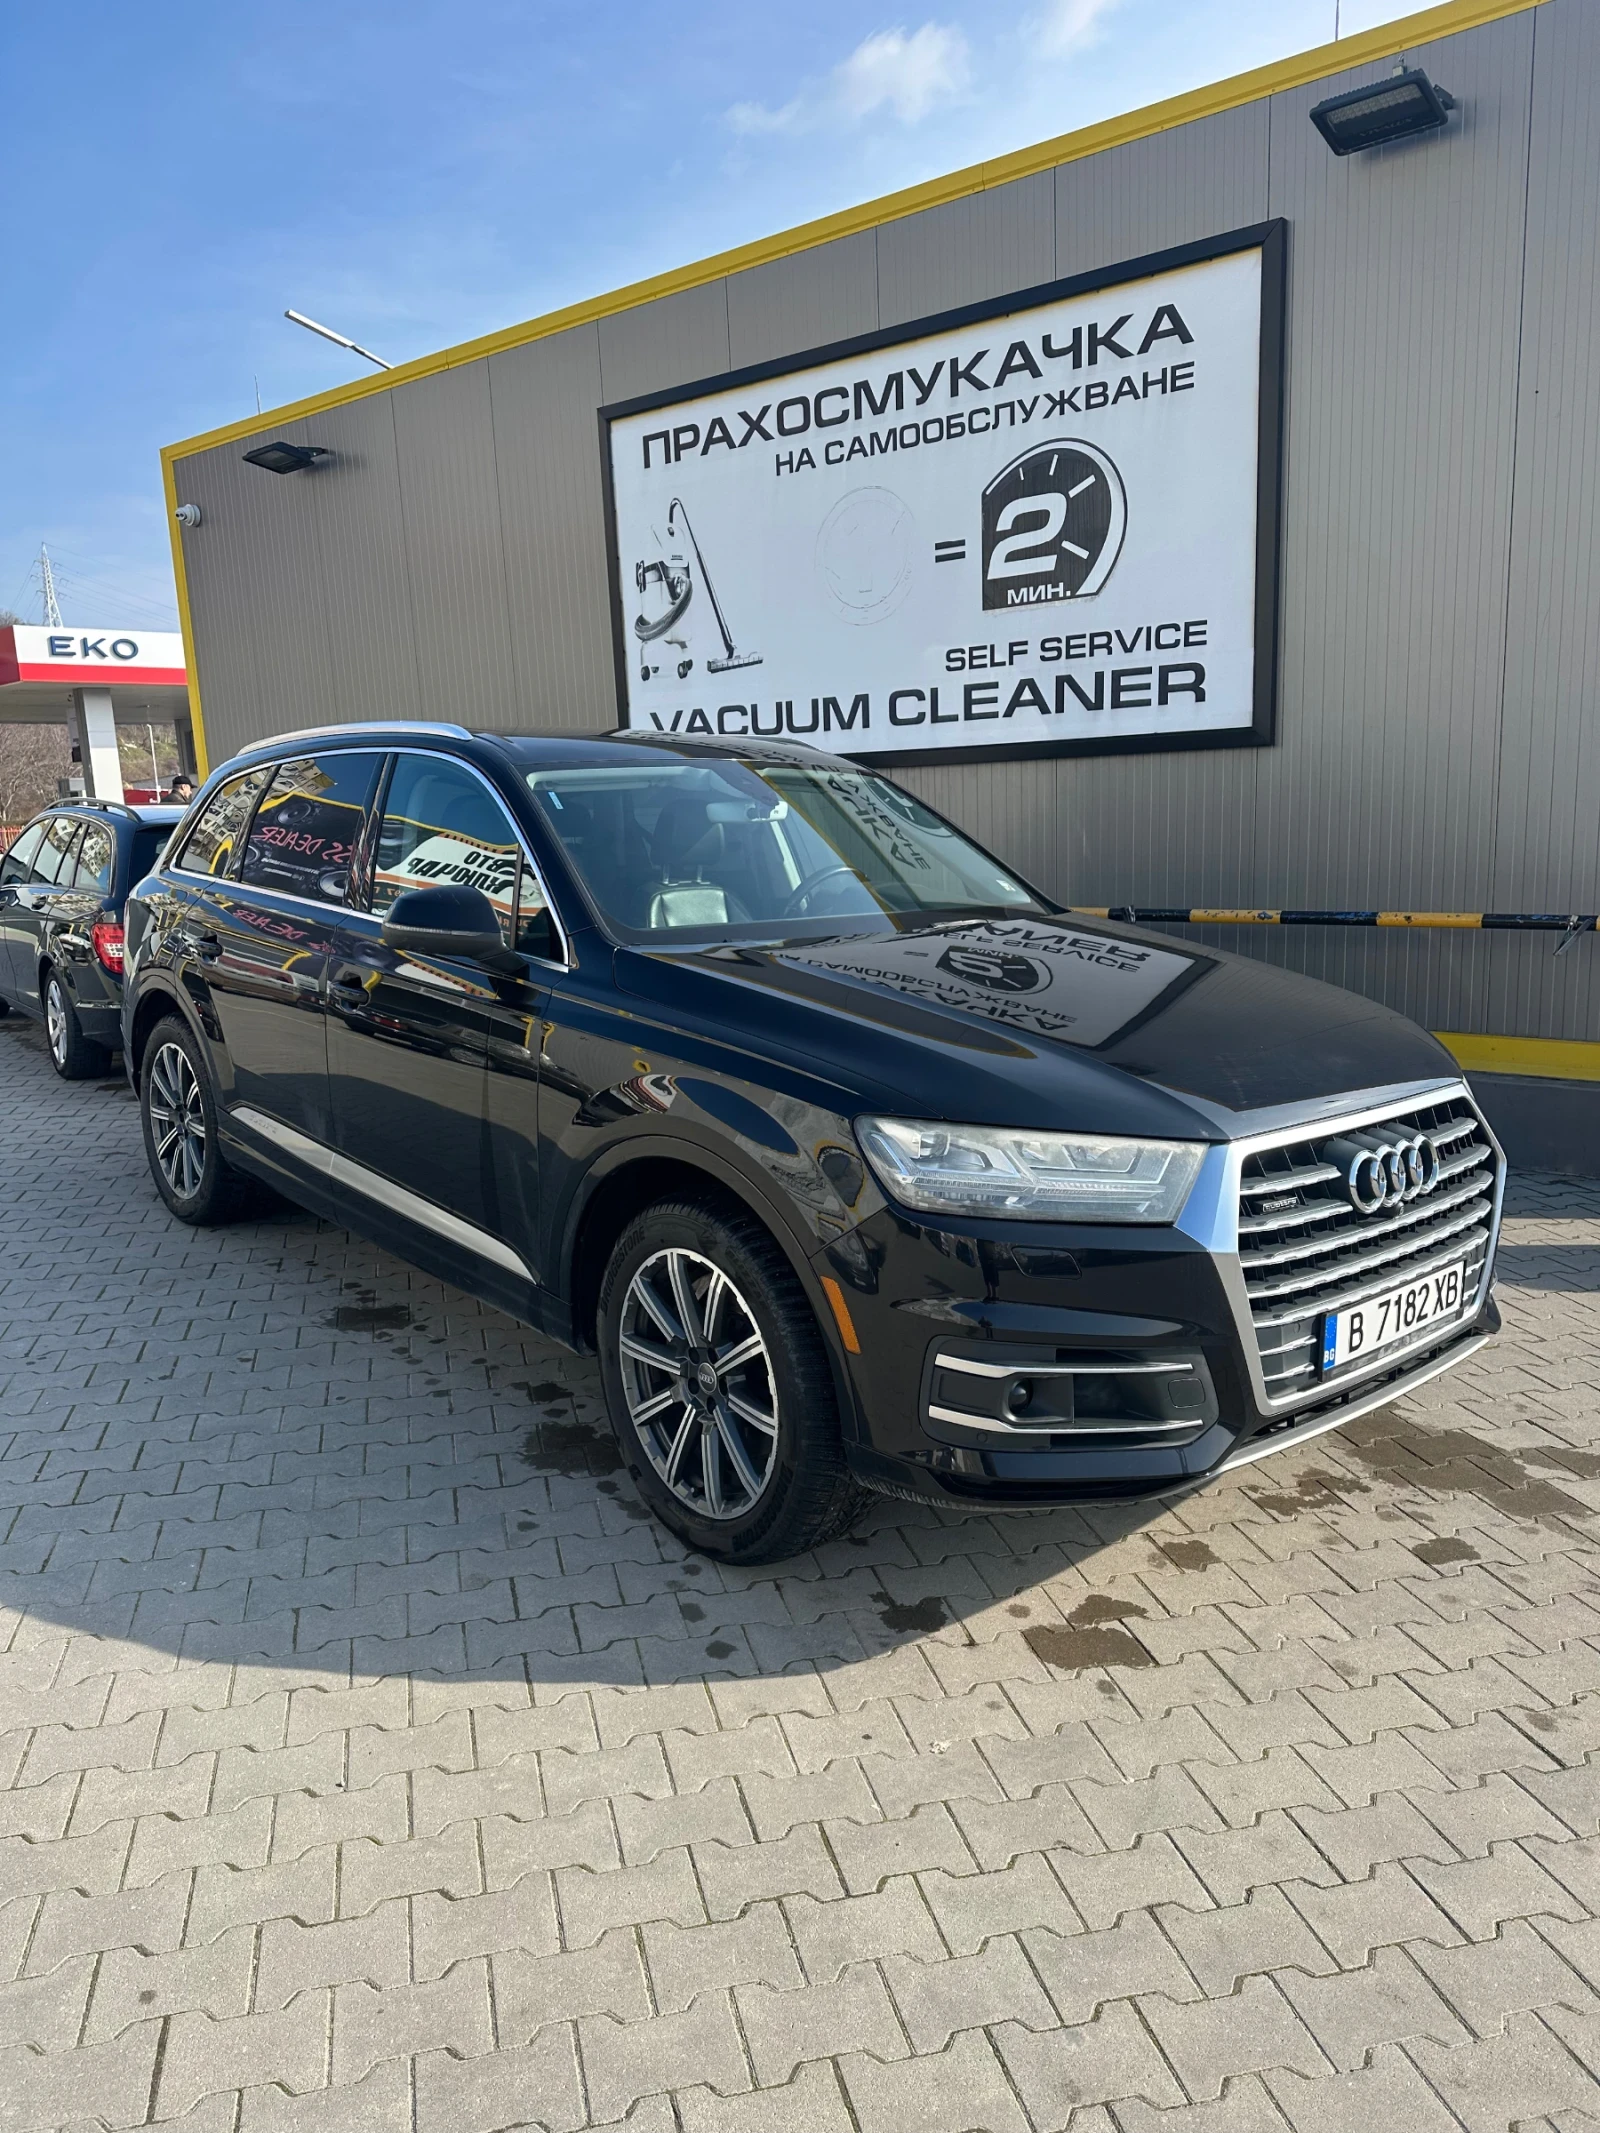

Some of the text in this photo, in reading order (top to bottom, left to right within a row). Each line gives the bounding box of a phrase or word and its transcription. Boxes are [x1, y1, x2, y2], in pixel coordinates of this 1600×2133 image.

[642, 303, 1195, 469] ПРАХОСМУКАЧКА
[775, 361, 1196, 477] НА САМООБСЛУЖВАНЕ
[986, 491, 1068, 581] 2
[1006, 582, 1071, 606] МИН.
[48, 636, 139, 660] EKO
[945, 620, 1208, 673] SELF SERVICE
[650, 662, 1207, 736] VACUUM CLEANER
[600, 1225, 647, 1317] BRIDGESTONE
[1348, 1270, 1459, 1354] B 7182 XB
[1323, 1347, 1335, 1363] BG
